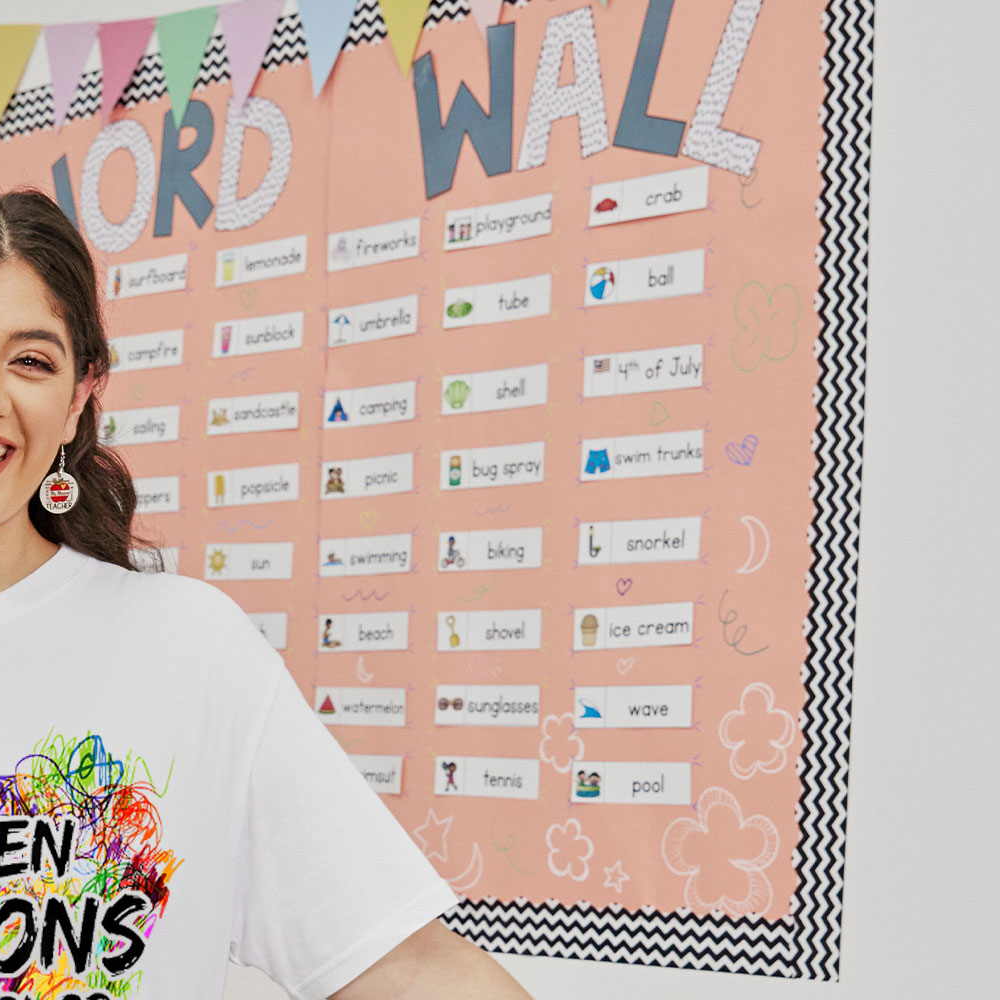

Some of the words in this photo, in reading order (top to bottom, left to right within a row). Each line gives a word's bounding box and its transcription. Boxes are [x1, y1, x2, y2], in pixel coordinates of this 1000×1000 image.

[413, 0, 763, 200] WALL
[645, 184, 684, 207] crab
[475, 202, 552, 237] playground
[357, 230, 418, 257] fireworks
[246, 248, 302, 272] lemonade
[129, 264, 187, 288] surfboard
[648, 265, 675, 289] ball
[499, 292, 529, 312] tube
[360, 308, 411, 333] umbrella
[245, 323, 296, 346] sunblock
[128, 341, 178, 361] campfire
[618, 358, 641, 381] 4th
[645, 359, 663, 380] of
[669, 355, 702, 379] July
[496, 377, 526, 400] shell
[234, 403, 296, 424] sandcastle
[359, 397, 408, 416] camping
[133, 418, 166, 437] sailing
[614, 447, 651, 465] swim
[657, 440, 703, 461] trunks
[365, 469, 399, 490] picnic
[472, 459, 499, 481] bug
[503, 455, 542, 479] spray
[240, 474, 291, 499] popsicle
[46, 502, 73, 510] TEACHER
[488, 542, 525, 565] biking
[626, 535, 686, 554] snorkel
[251, 557, 271, 572] sun
[350, 547, 407, 571] swimming
[358, 623, 395, 642] beach
[485, 621, 526, 641] shovel
[608, 621, 632, 638] ice
[637, 619, 690, 637] cream
[342, 699, 404, 716] watermelon
[467, 696, 539, 718] sunglasses
[628, 702, 669, 717] wave
[483, 770, 524, 790] tennis
[631, 774, 666, 798] pool
